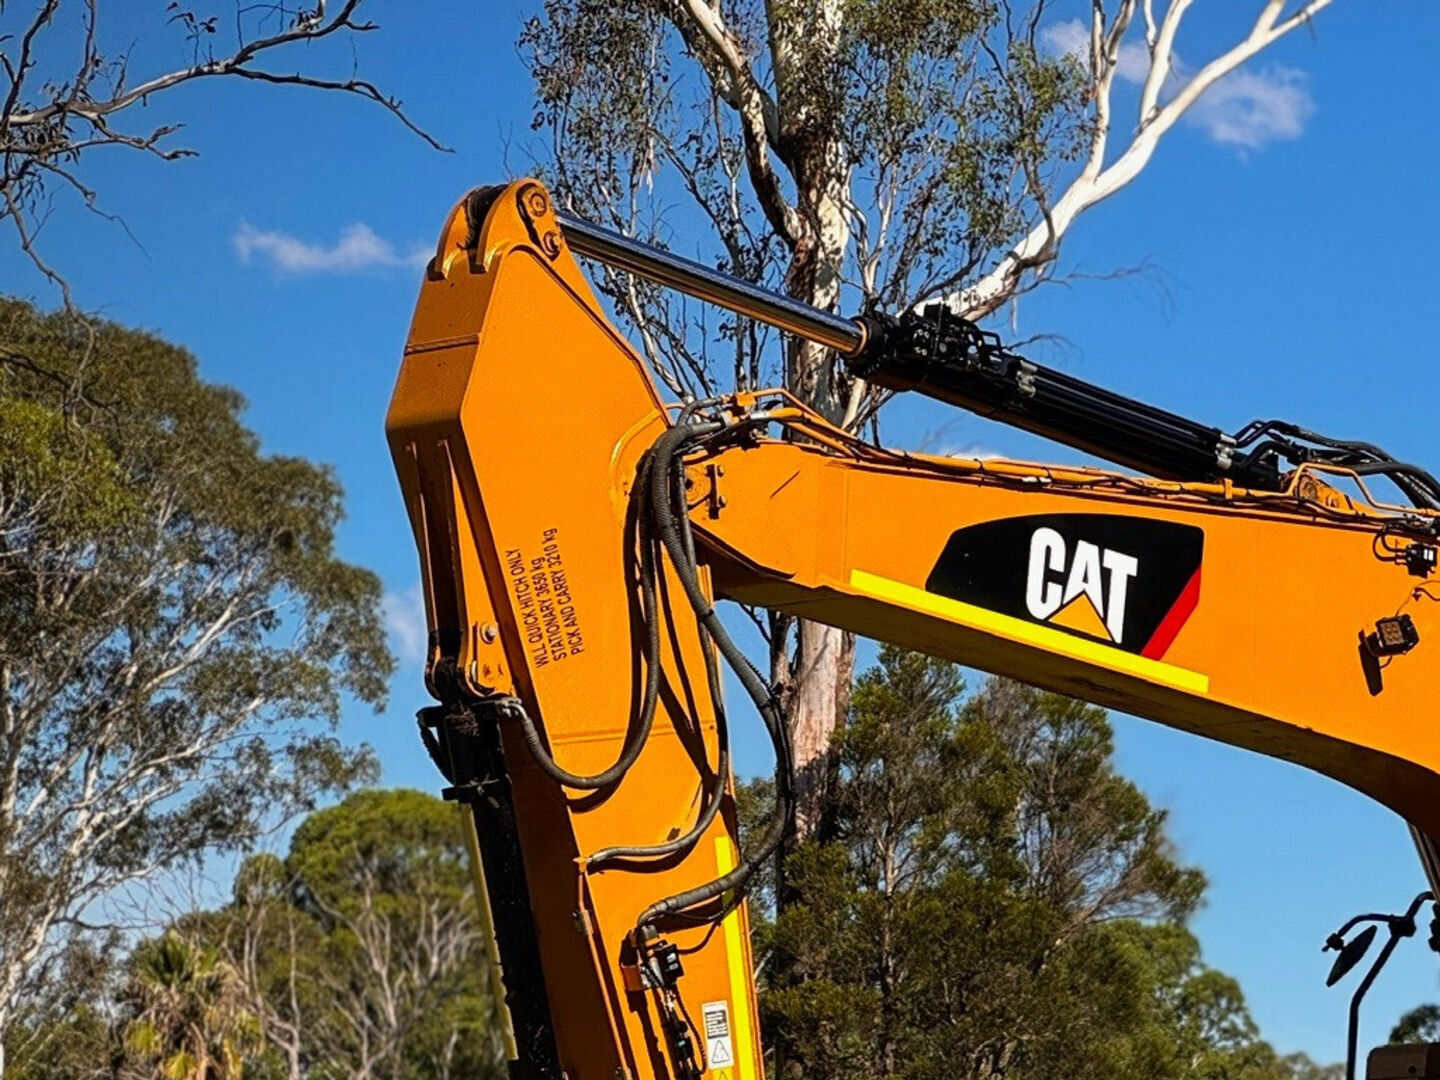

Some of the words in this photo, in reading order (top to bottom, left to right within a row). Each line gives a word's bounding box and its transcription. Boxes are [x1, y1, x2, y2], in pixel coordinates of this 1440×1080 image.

[542, 528, 558, 544] kg
[505, 548, 525, 576] ONLY
[530, 556, 546, 573] kg
[543, 543, 562, 568] 3210
[513, 576, 534, 610] HITCH
[531, 573, 550, 597] 3650
[550, 569, 572, 606] CARRY
[1025, 527, 1138, 644] CAT
[522, 609, 543, 643] QUICK
[538, 598, 567, 661] STATIONARY
[560, 606, 578, 628] AND
[532, 643, 550, 668] WLL
[567, 627, 585, 656] PICK
